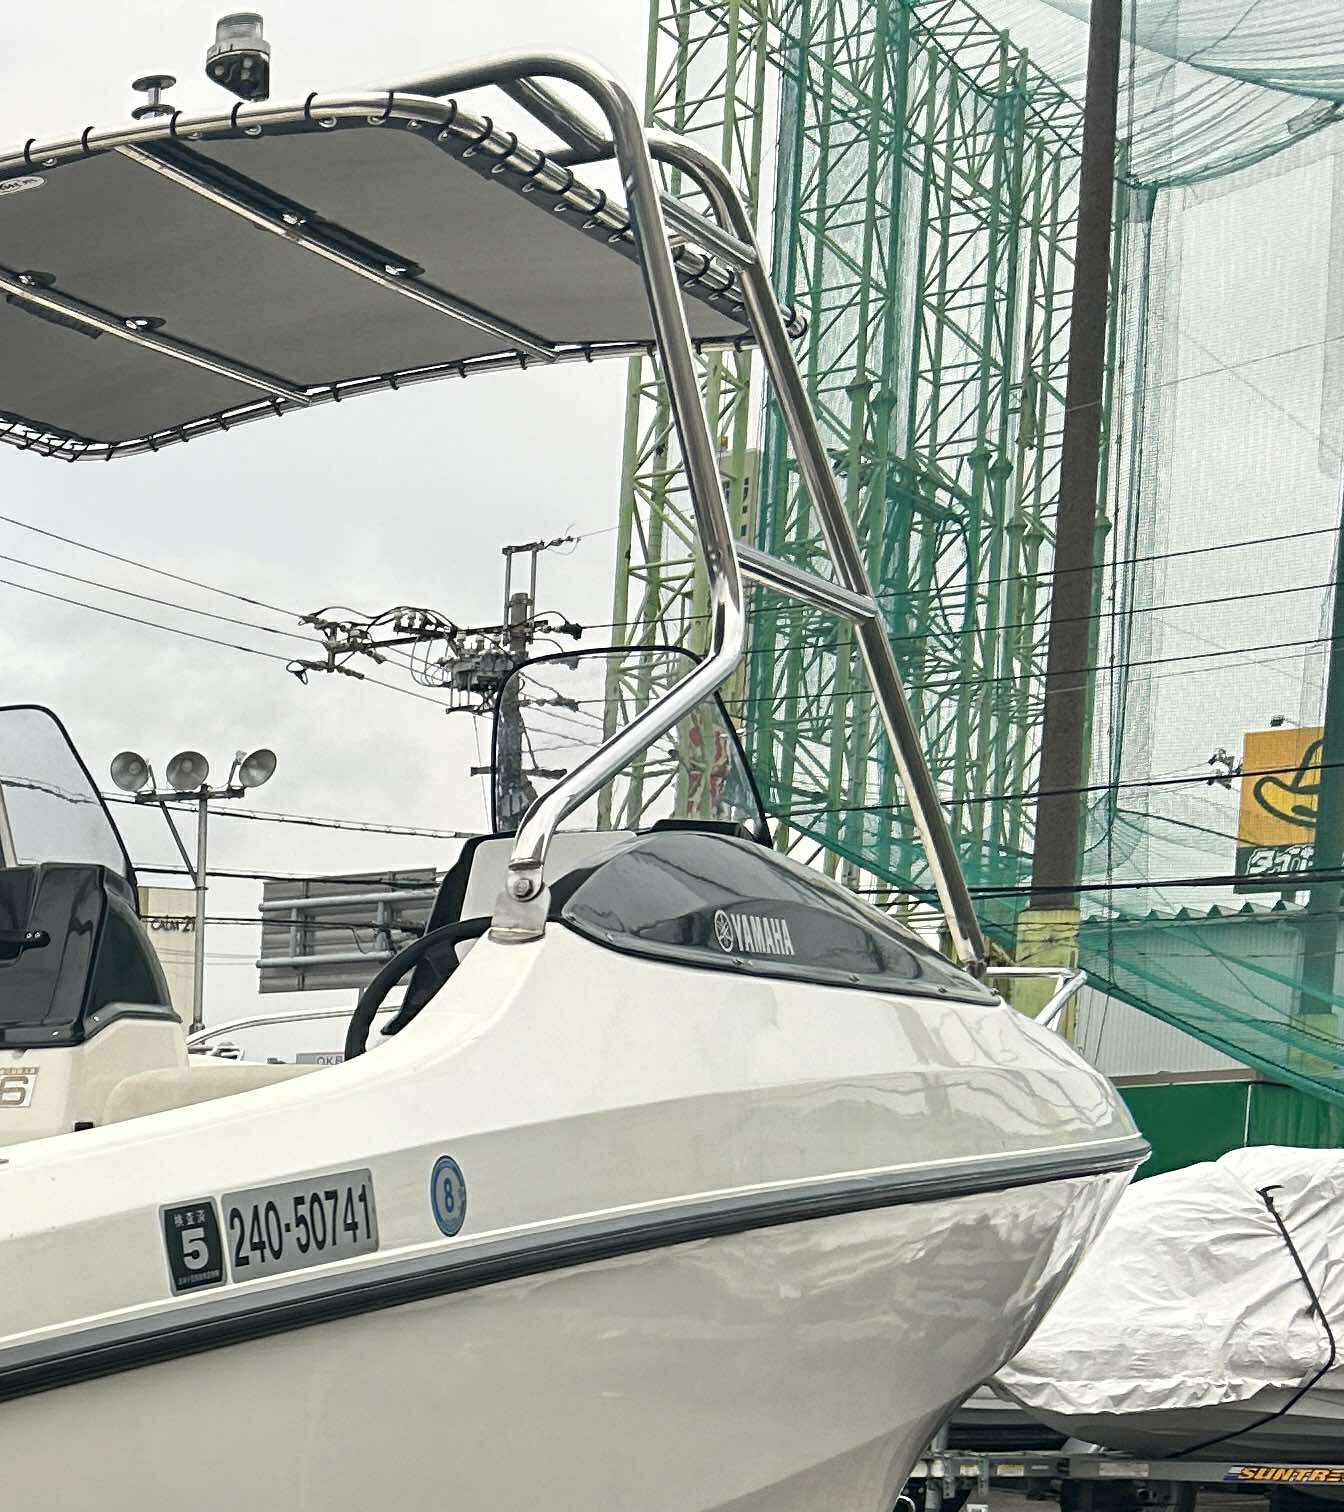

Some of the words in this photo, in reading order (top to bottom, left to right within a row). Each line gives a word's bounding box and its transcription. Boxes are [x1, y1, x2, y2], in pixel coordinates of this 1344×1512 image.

[730, 913, 795, 955] YAMAHA
[443, 1178, 454, 1213] 8
[229, 1184, 371, 1267] 240-50741
[182, 1227, 209, 1270] 5
[1238, 1467, 1344, 1482] SUNTRE
